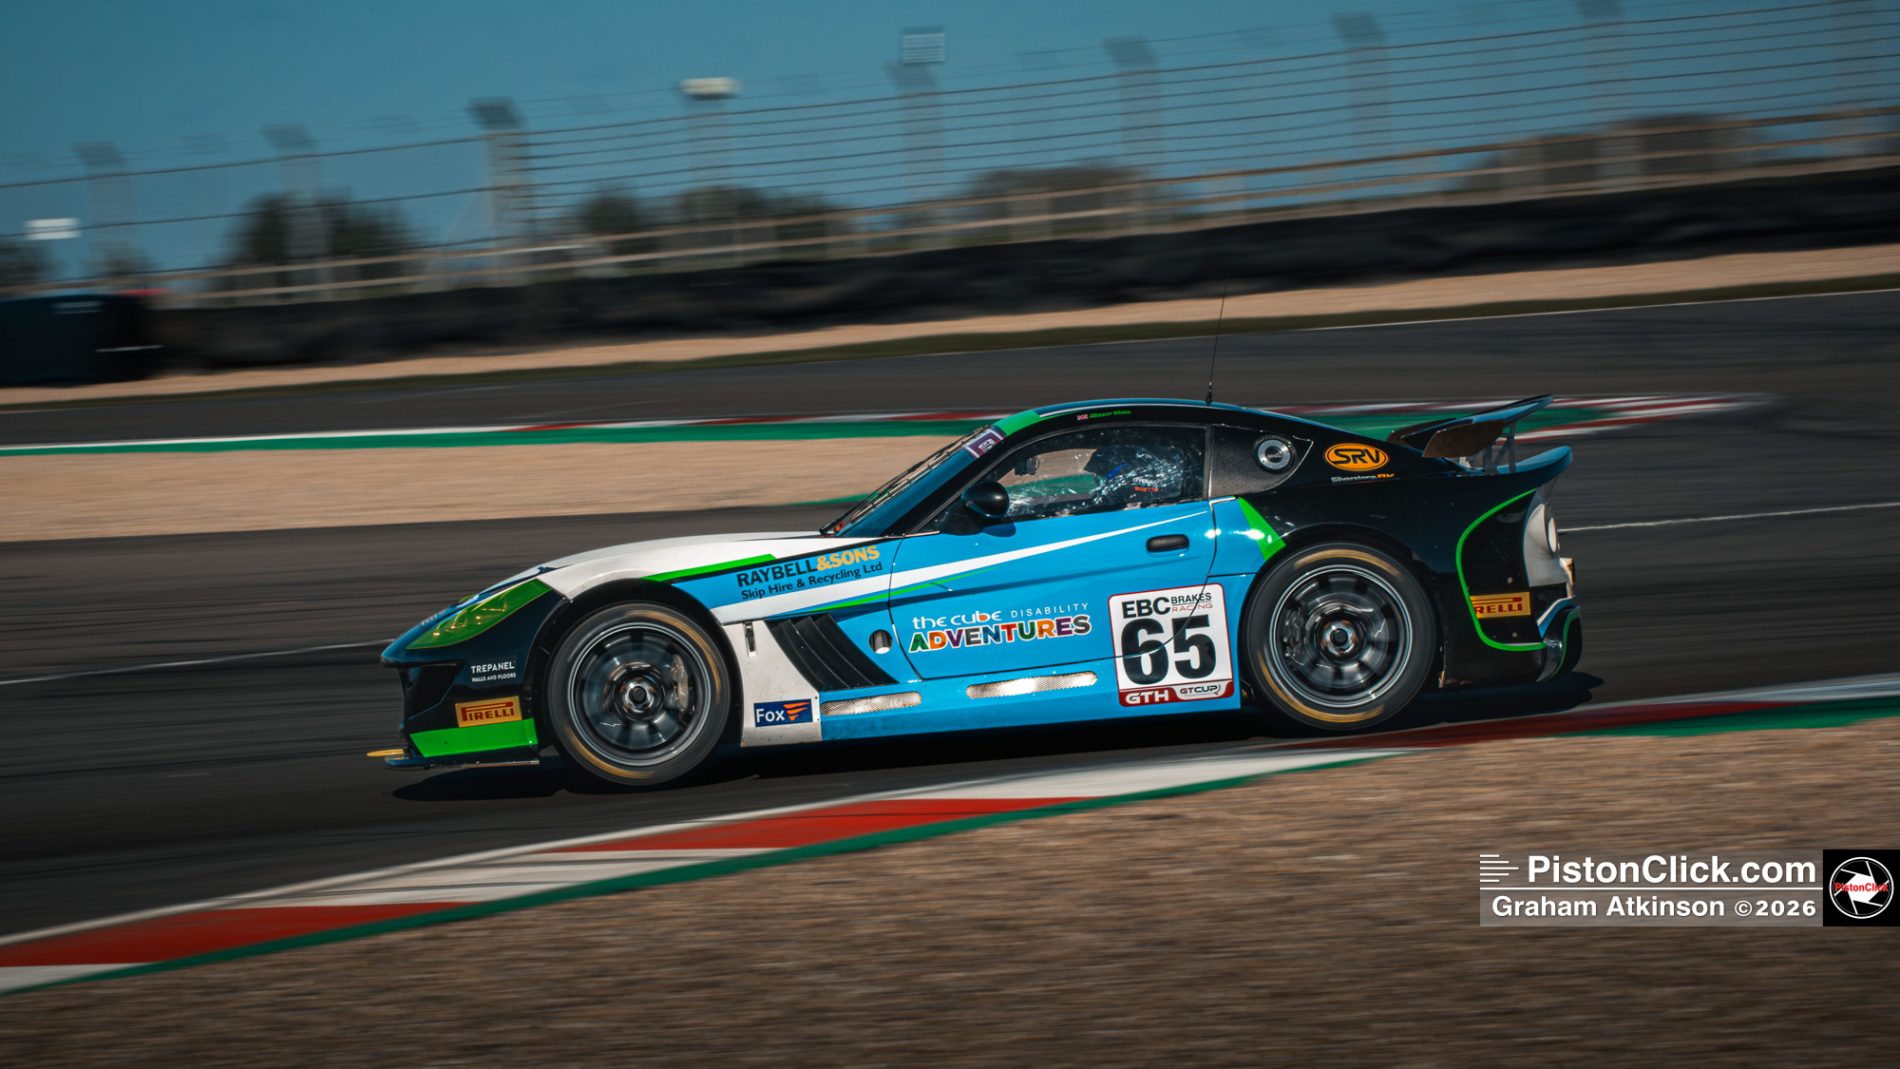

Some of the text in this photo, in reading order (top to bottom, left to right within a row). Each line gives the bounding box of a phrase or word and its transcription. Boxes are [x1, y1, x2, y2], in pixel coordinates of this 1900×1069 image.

[1333, 448, 1380, 465] SRV
[741, 562, 883, 600] Skip Hire & Recycling Ltd
[1122, 592, 1212, 619] EBC BRAKES
[1172, 602, 1213, 612] RACNG
[1474, 598, 1522, 614] RELLI
[912, 603, 1088, 630] the cube DISABILITY
[909, 614, 1091, 653] ADVENTURES
[1121, 614, 1217, 685] 65
[471, 661, 515, 674] TREPANEL
[1125, 690, 1170, 704] GTH
[461, 701, 514, 721] PIRELLI
[756, 708, 785, 723] Fox
